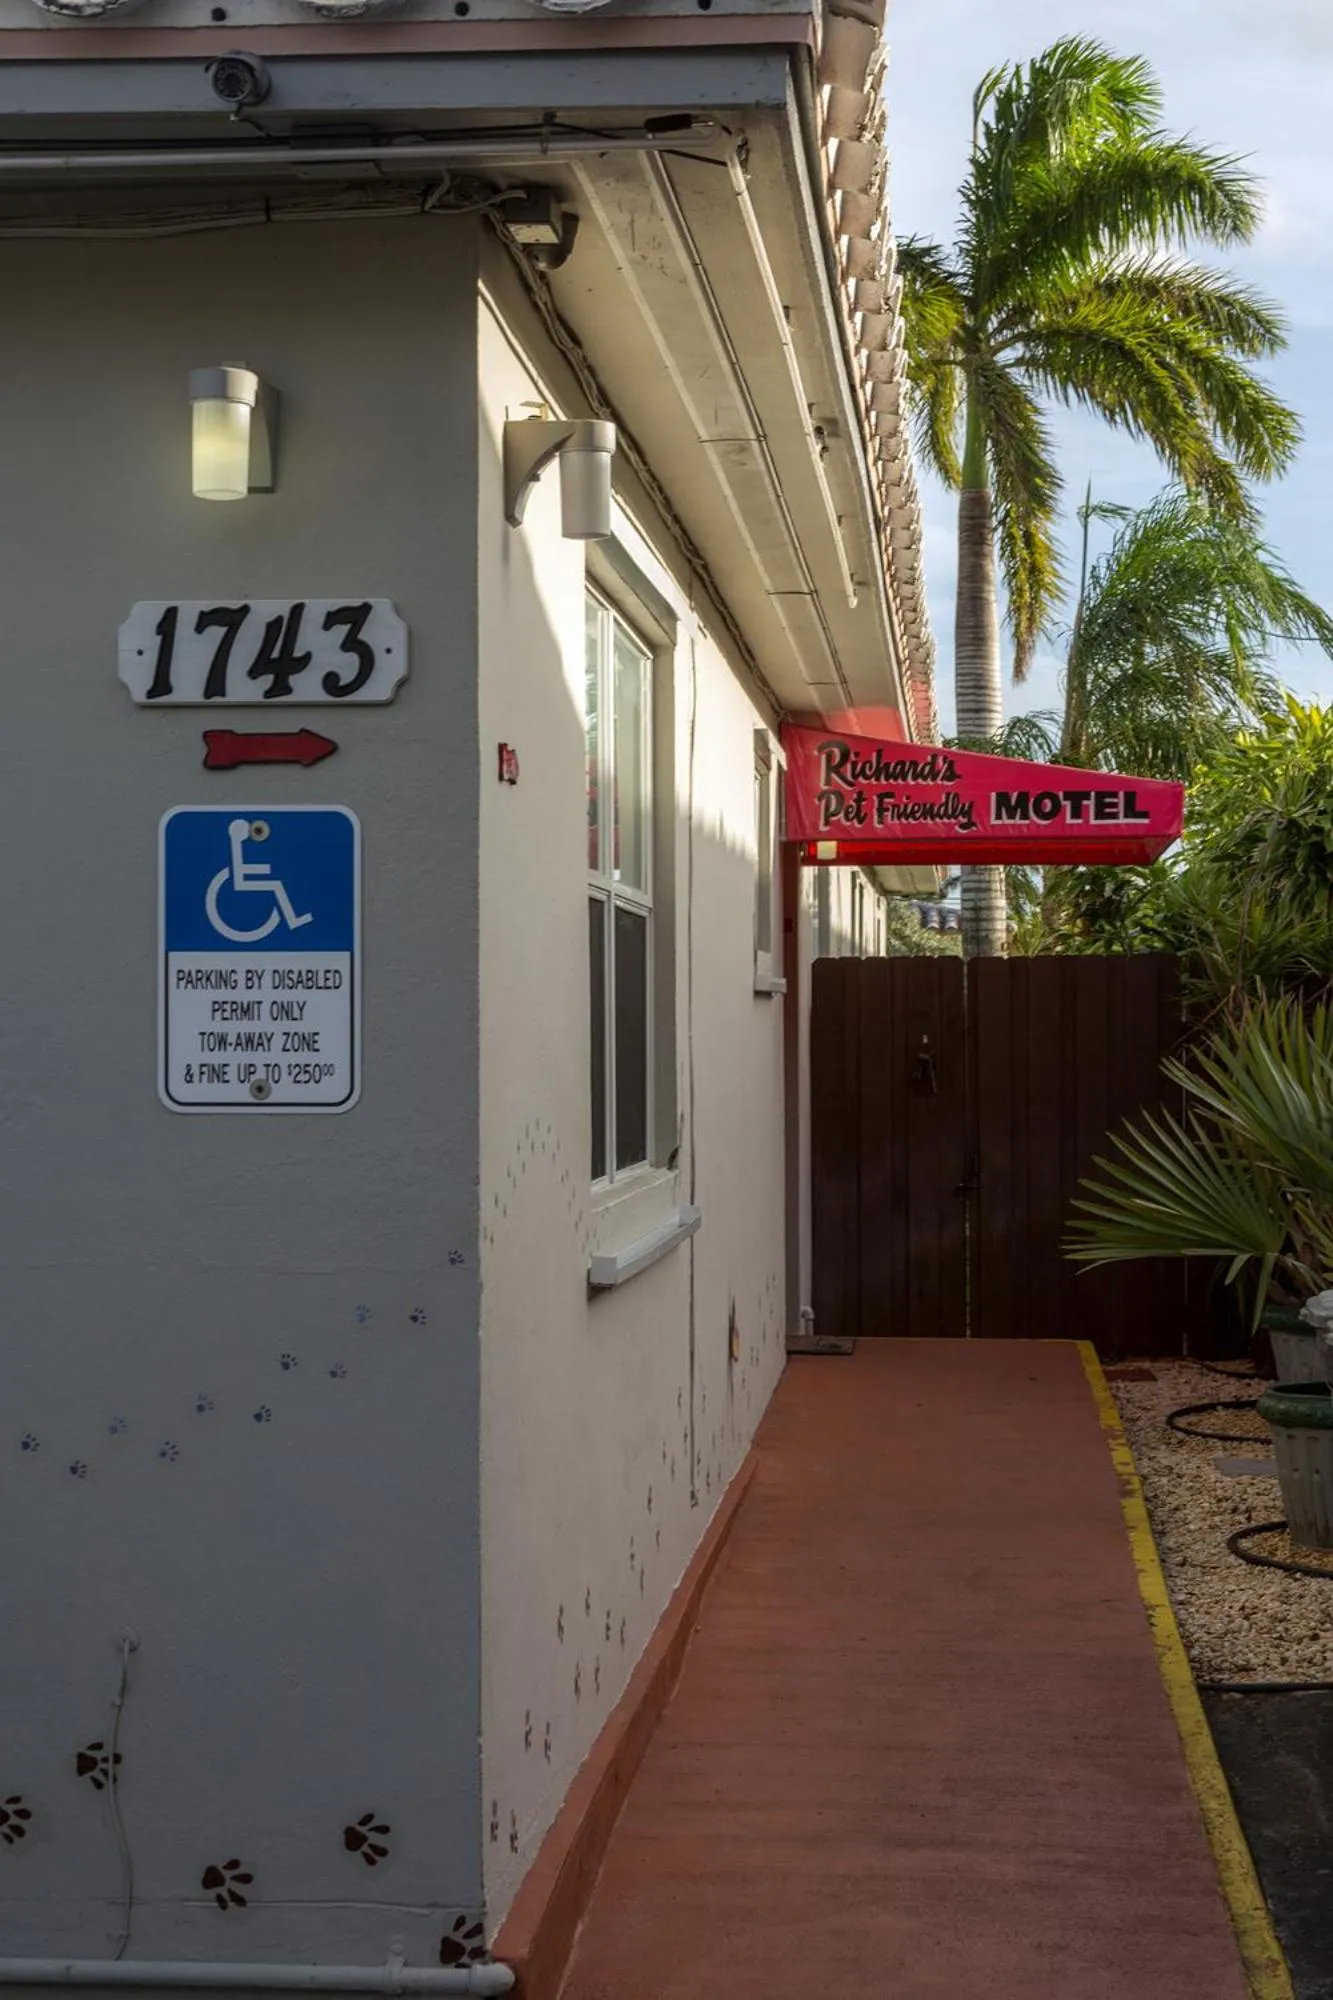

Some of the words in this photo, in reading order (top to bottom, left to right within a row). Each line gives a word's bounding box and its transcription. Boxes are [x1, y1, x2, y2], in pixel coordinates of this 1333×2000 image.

[146, 602, 376, 700] 1743
[816, 740, 961, 789] Richard's
[816, 789, 869, 832] Pet
[872, 790, 977, 833] Friendly
[990, 790, 1151, 825] MOTEL
[176, 969, 238, 990] PARKING
[245, 969, 265, 990] BY
[272, 969, 342, 990] DISABLED
[211, 1001, 263, 1021] PERMIT
[270, 1001, 307, 1021] ONLY
[198, 1032, 274, 1052] TOW-AWAY
[282, 1032, 320, 1052] ZONE
[184, 1063, 194, 1084] &
[199, 1063, 230, 1083] FINE
[237, 1063, 257, 1083] UP
[263, 1063, 282, 1084] TO
